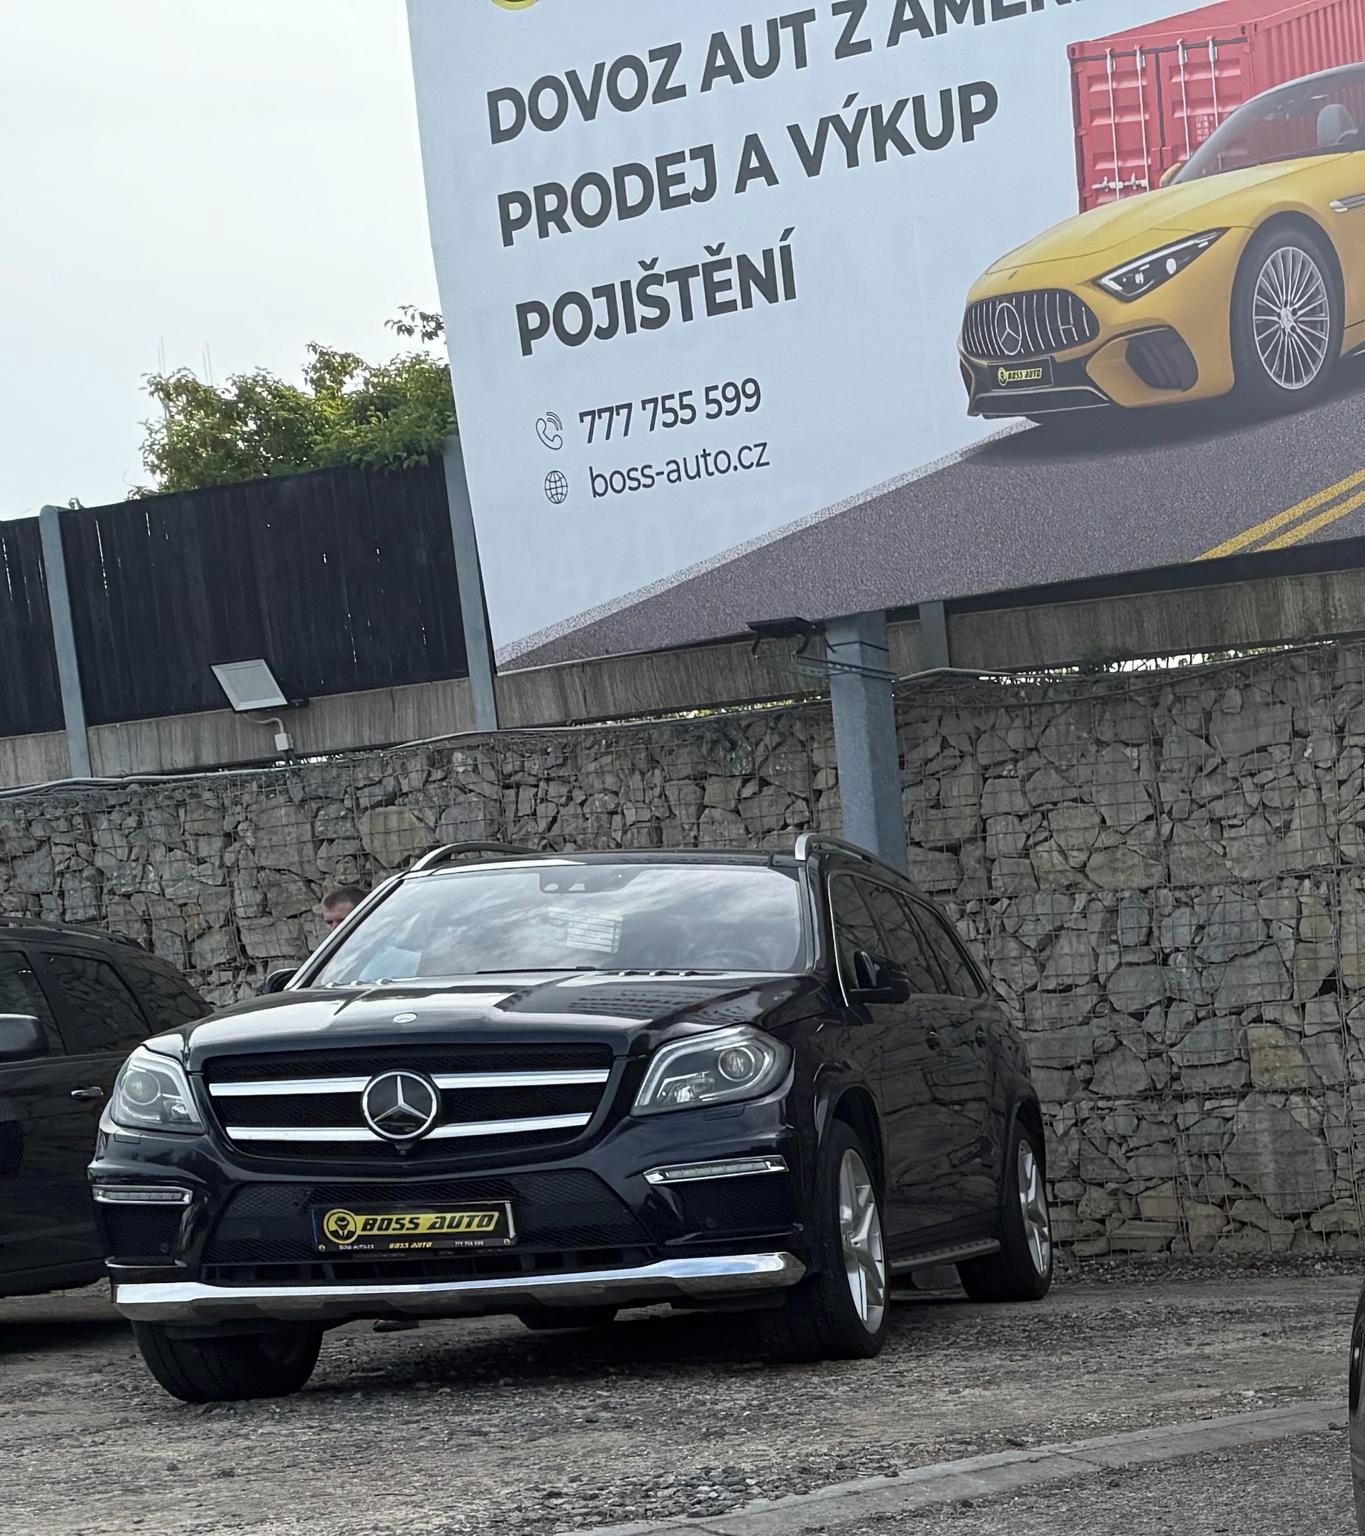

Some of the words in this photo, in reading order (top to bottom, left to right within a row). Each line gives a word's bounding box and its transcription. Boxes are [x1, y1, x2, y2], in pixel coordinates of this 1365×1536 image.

[486, 42, 687, 145] DOVOZ
[699, 8, 816, 94] AUT
[831, 0, 872, 60] Z
[497, 143, 718, 247] PRODEJ
[734, 132, 780, 194] A
[786, 80, 999, 178] VÝKUP
[515, 226, 797, 357] POJIŠTĚNÍ
[579, 402, 633, 444] 777
[641, 389, 697, 432] 755
[704, 377, 761, 420] 599
[589, 441, 770, 498] boss-auto.cz
[360, 1216, 421, 1232] BOSS
[427, 1213, 496, 1231] AUTO
